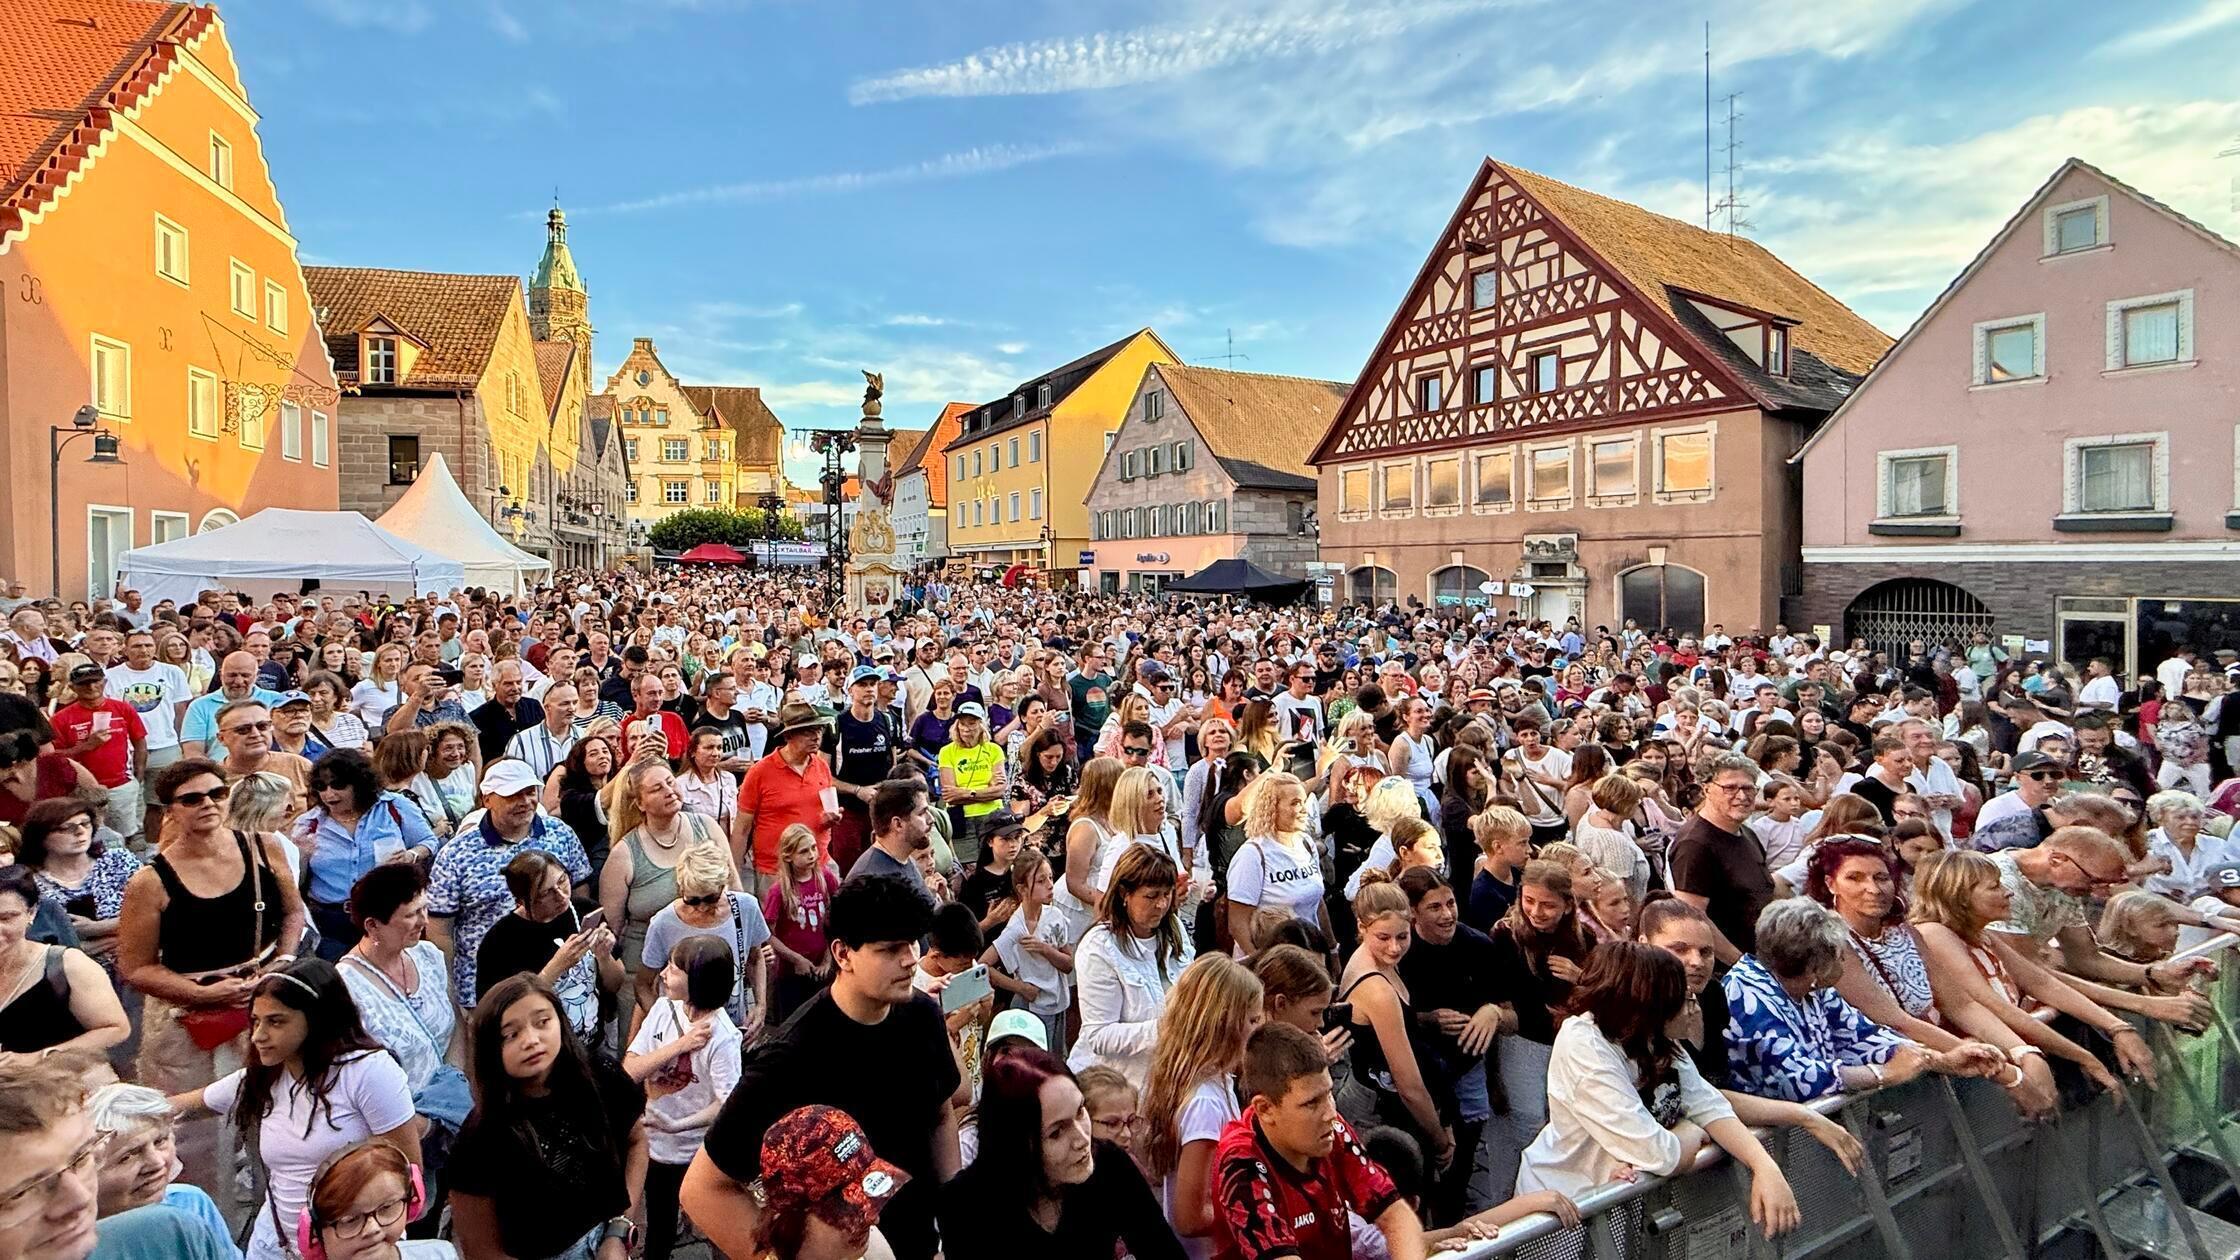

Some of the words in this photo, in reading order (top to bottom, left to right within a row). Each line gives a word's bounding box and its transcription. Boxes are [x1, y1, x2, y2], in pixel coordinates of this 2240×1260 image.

[1269, 868, 1301, 884] LOOK
[1301, 863, 1319, 879] BUS
[1294, 1211, 1315, 1229] JAKO
